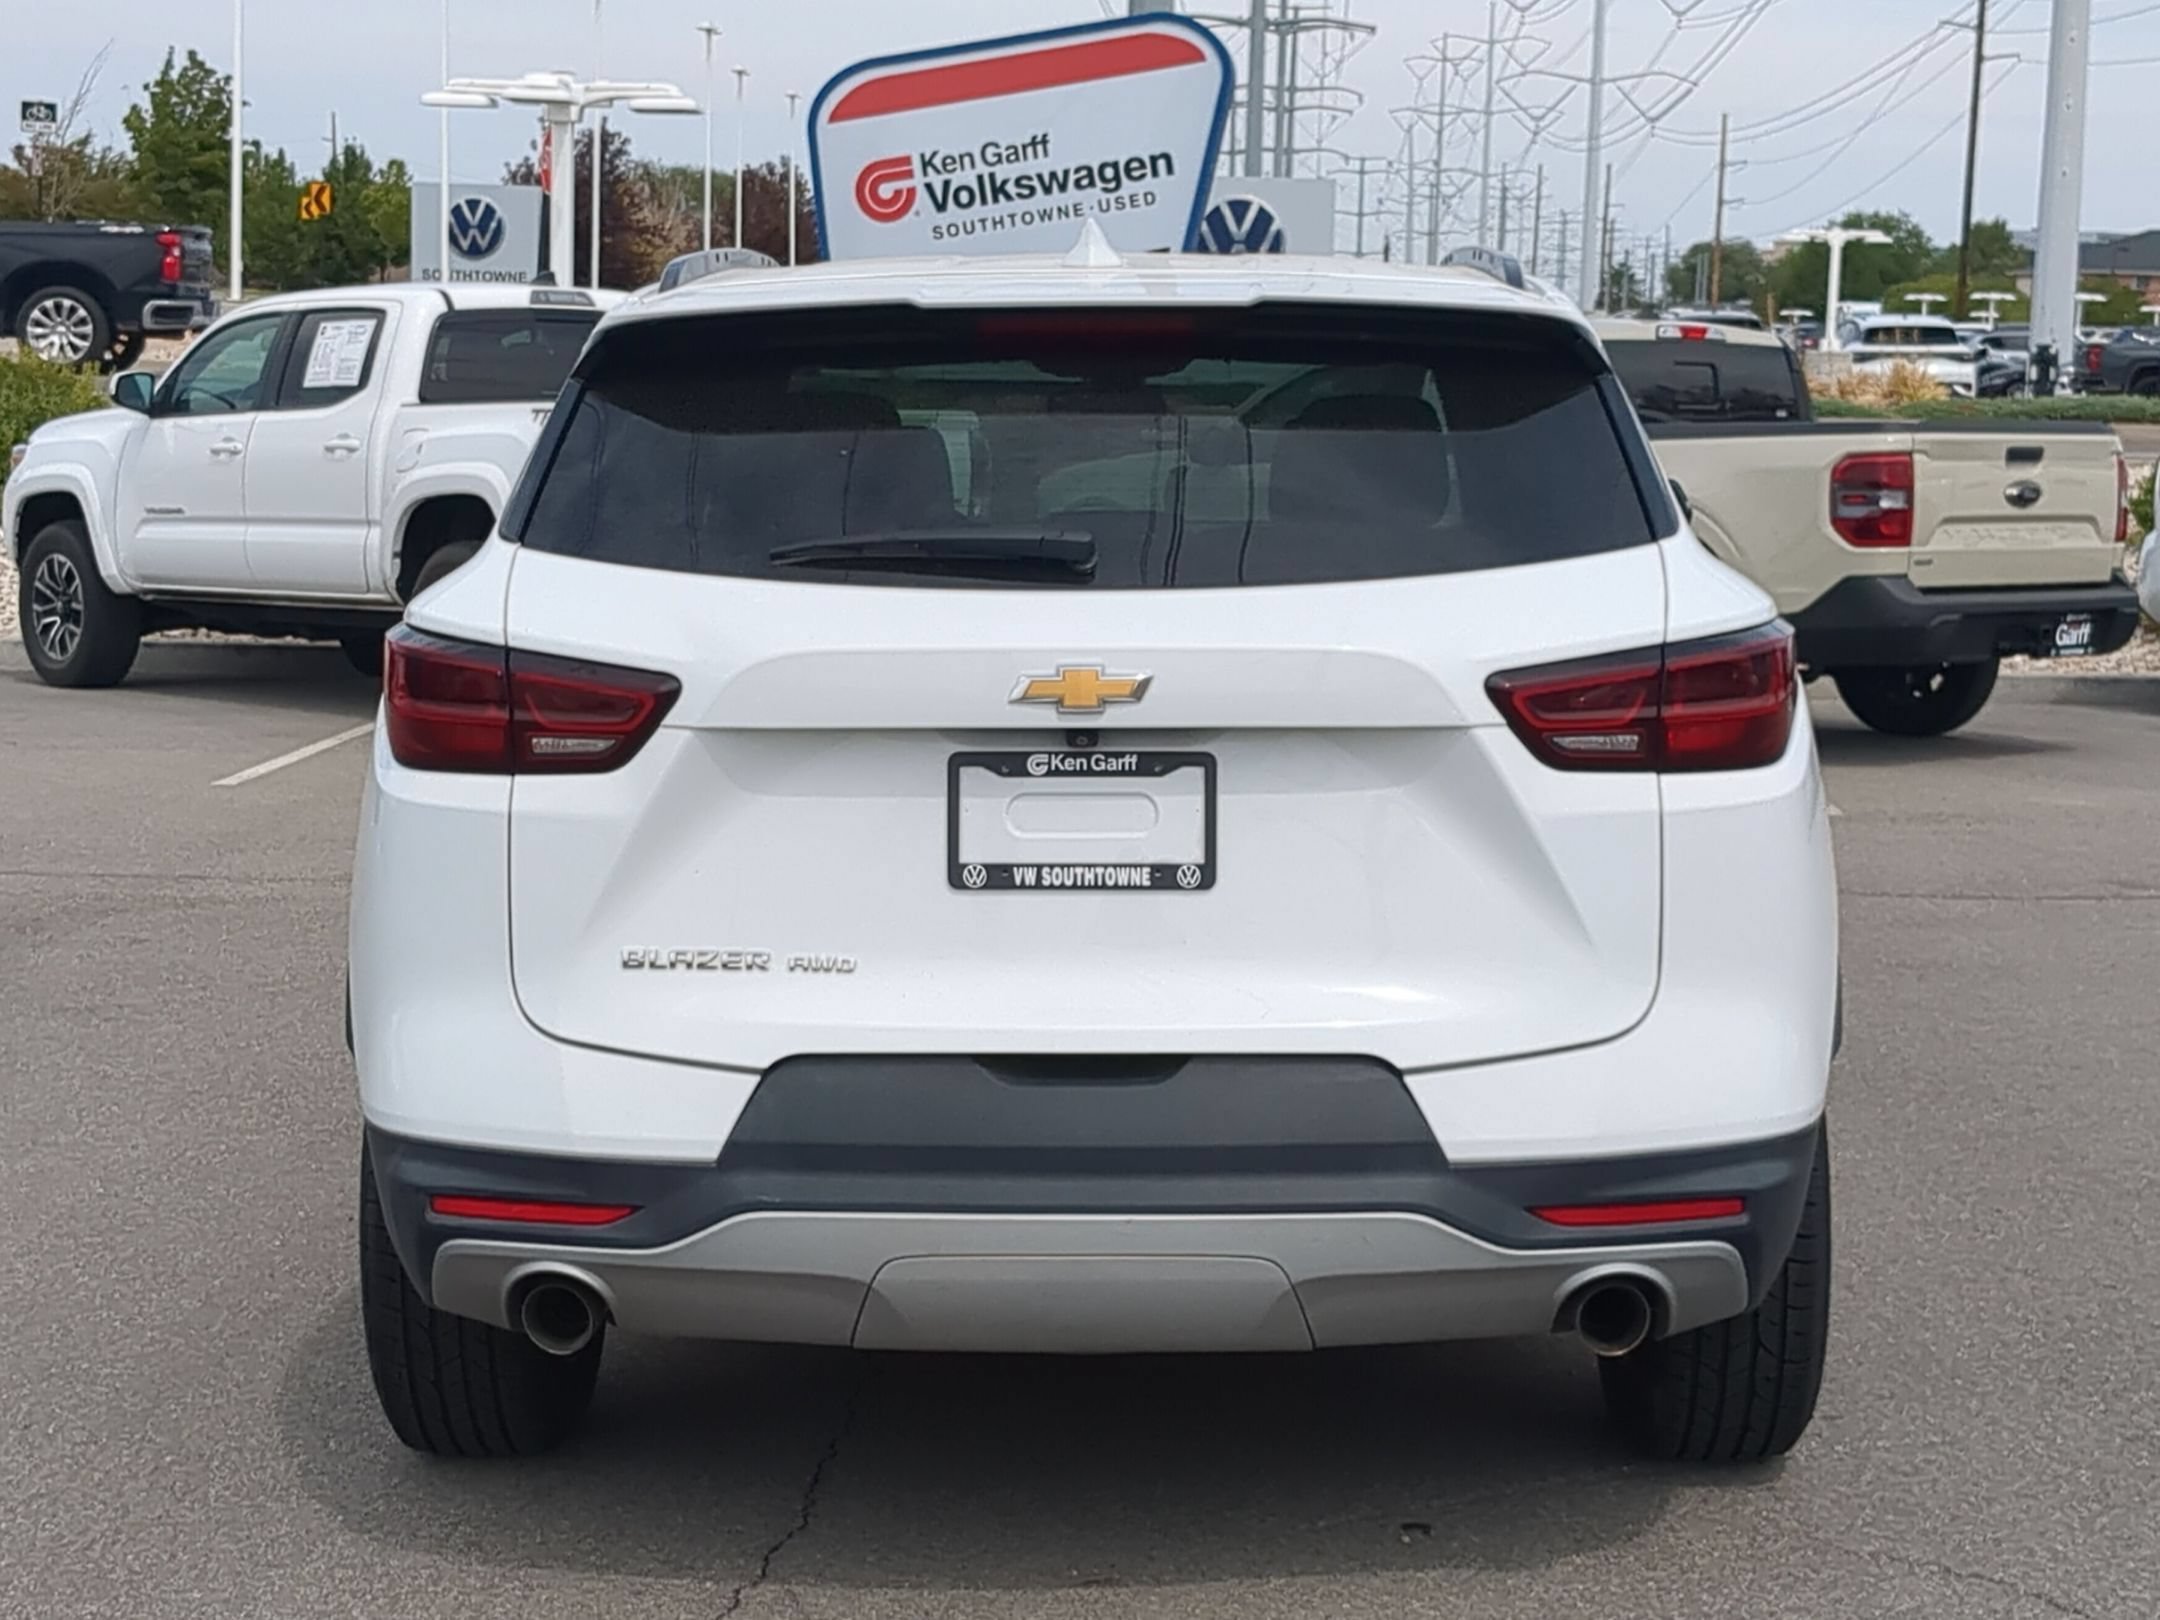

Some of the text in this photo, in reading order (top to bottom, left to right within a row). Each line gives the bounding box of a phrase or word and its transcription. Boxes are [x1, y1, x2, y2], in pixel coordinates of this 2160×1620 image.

[920, 132, 1050, 178] Ken Garff
[924, 150, 1176, 214] Volkswagen
[1051, 753, 1139, 772] Ken Garff
[1013, 867, 1152, 887] VW SOUTHTOWNE
[621, 948, 858, 974] BLAZER AWD
